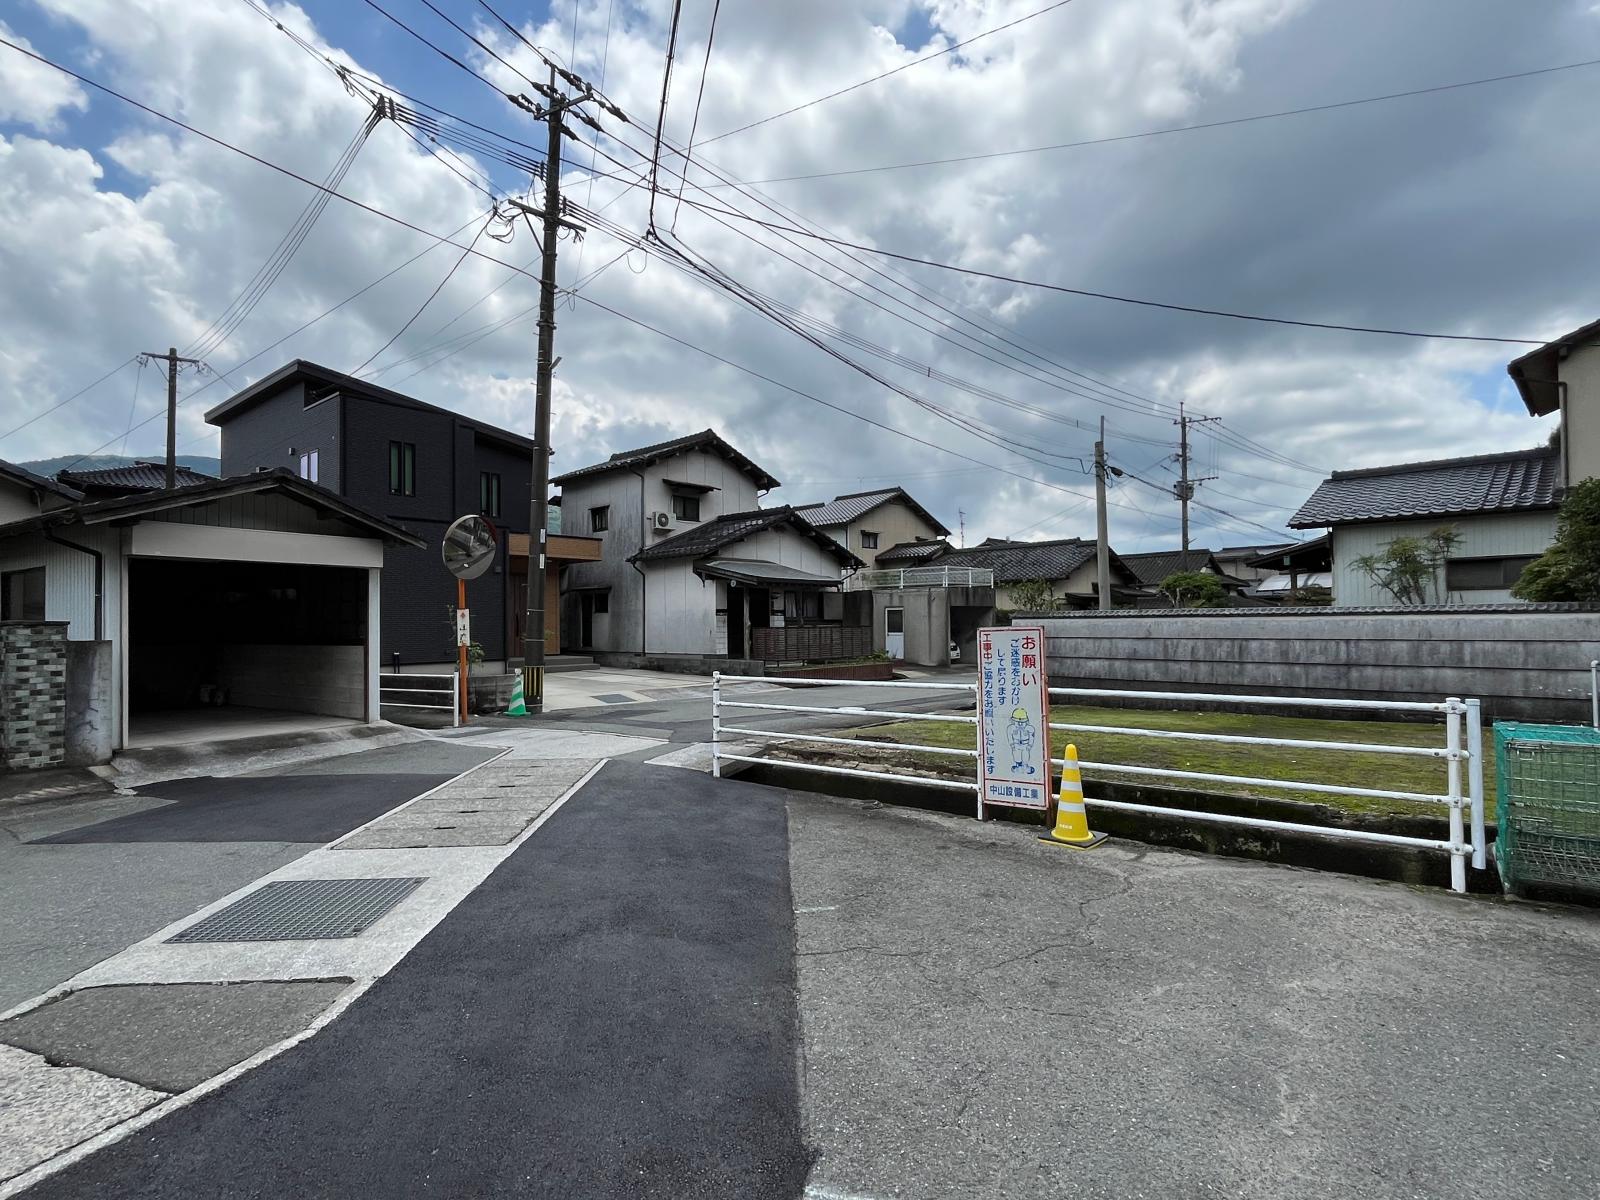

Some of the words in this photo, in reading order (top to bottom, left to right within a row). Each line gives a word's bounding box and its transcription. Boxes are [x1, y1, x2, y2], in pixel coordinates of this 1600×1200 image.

[1010, 638, 1021, 706] ご迷惑をおかけ
[1021, 635, 1037, 686] お願い
[990, 784, 1039, 800] 中山設備工業
